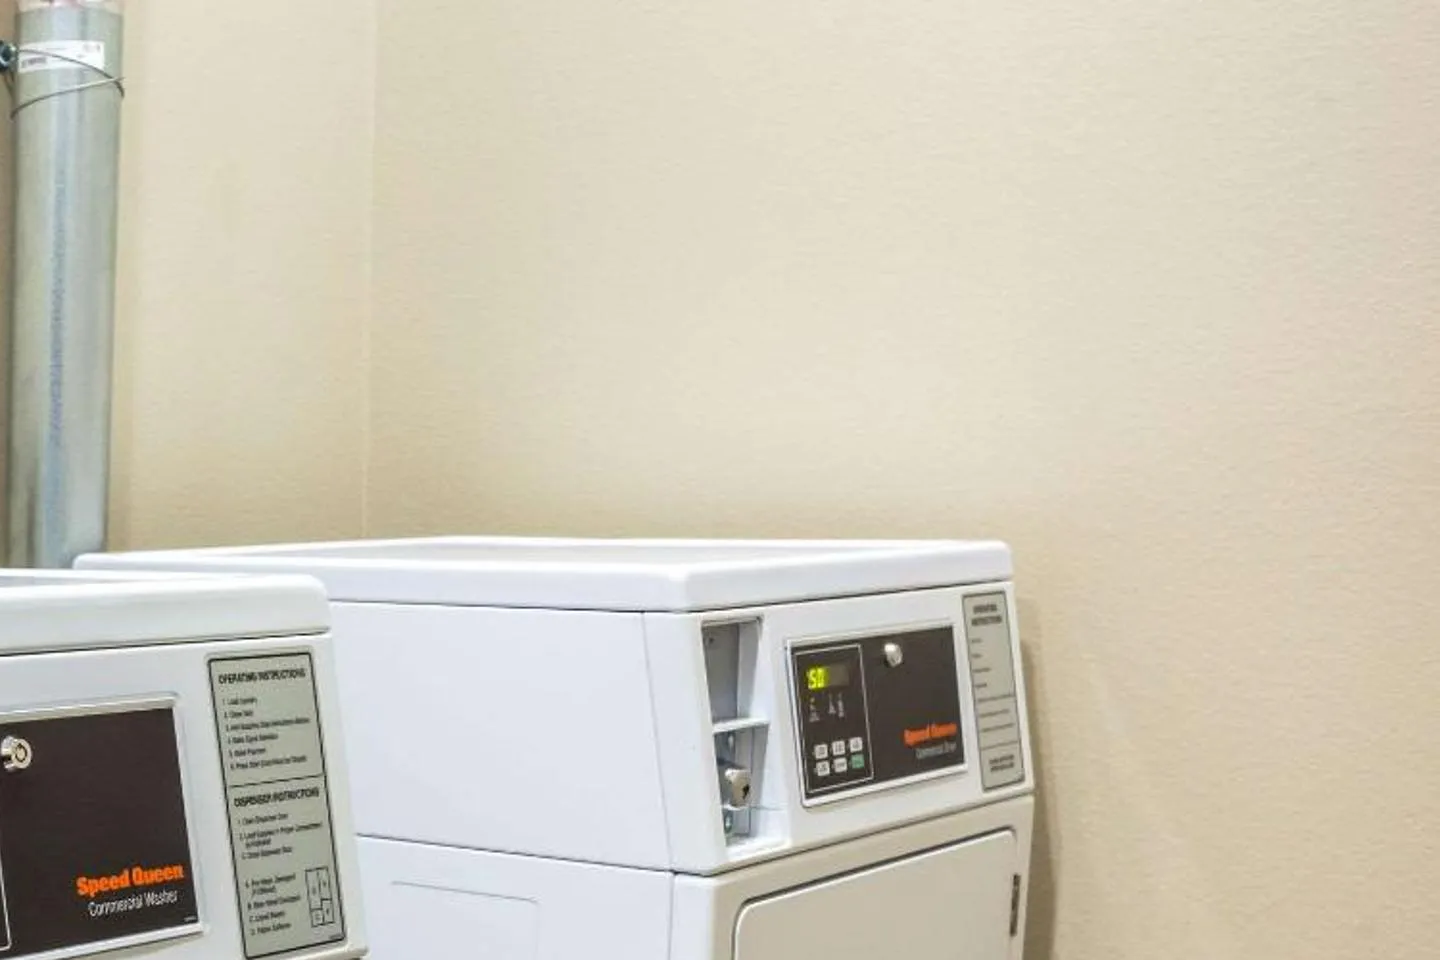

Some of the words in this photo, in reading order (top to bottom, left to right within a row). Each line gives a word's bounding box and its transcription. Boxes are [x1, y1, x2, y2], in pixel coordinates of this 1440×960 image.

[218, 670, 257, 684] OPERATING
[257, 667, 306, 682] INSTRUCTIONS
[76, 869, 130, 898] Speed
[131, 864, 184, 886] Queen
[87, 893, 143, 917] Commercial
[143, 888, 178, 907] Washer
